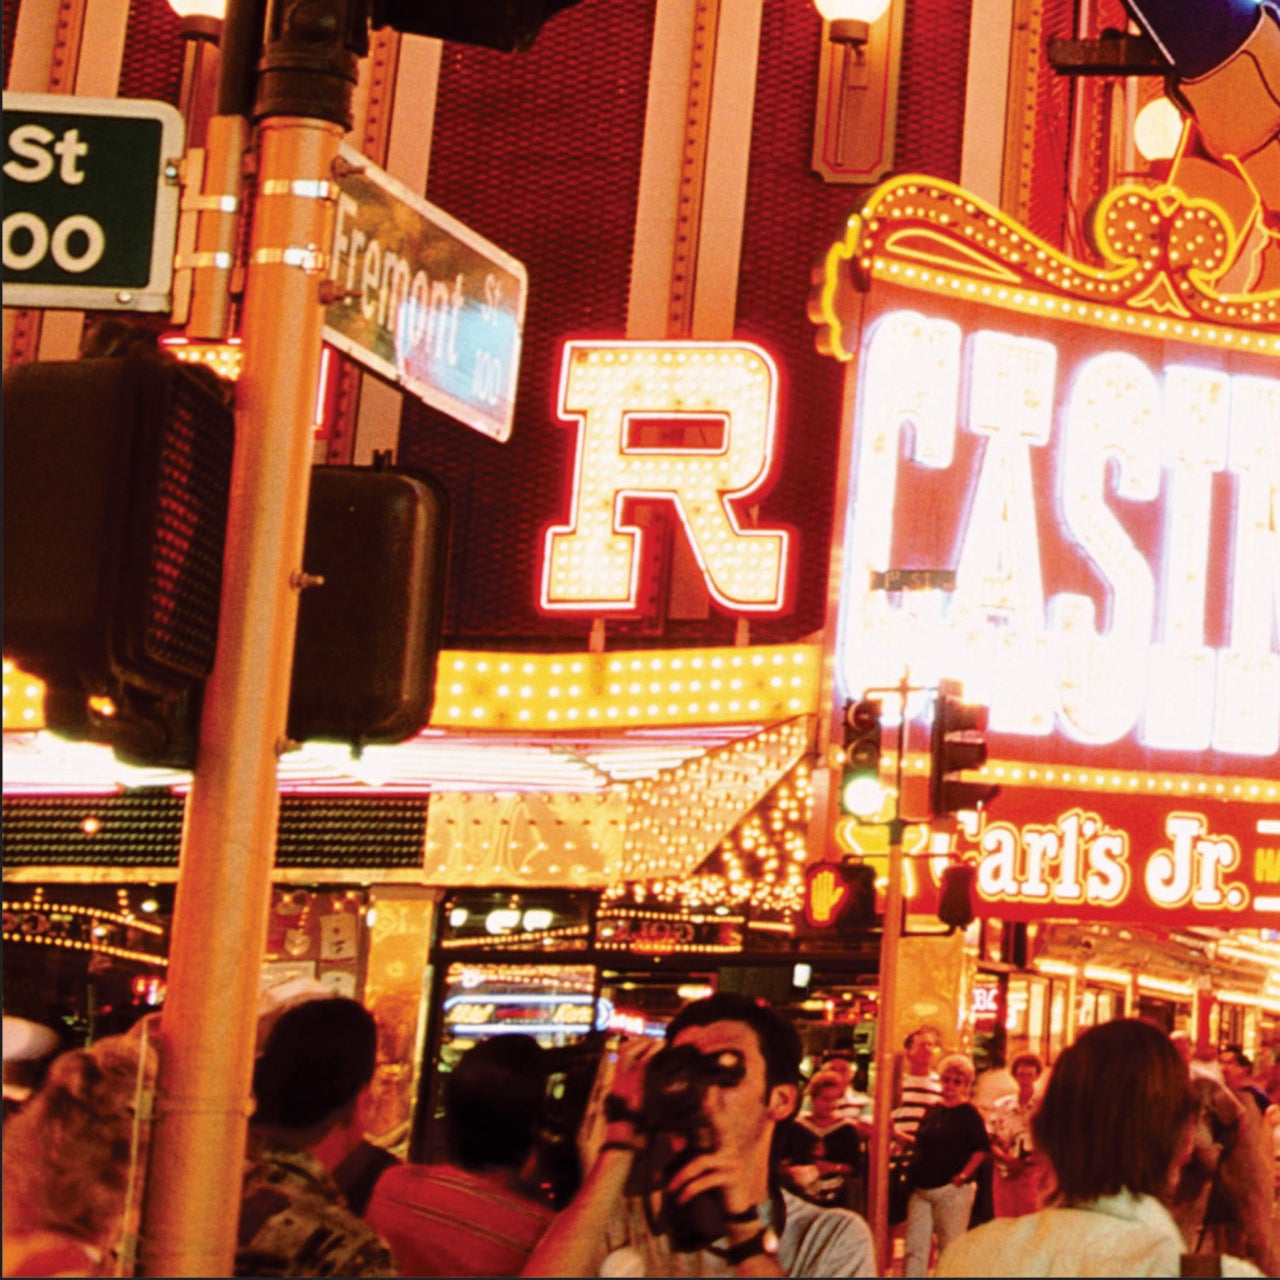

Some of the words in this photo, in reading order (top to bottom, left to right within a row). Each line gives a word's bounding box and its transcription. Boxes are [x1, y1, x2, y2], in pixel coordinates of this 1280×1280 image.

[3, 124, 88, 185] St
[330, 191, 465, 367] Fremont
[484, 273, 502, 326] St
[540, 340, 789, 610] R
[1146, 811, 1249, 909] Jr.
